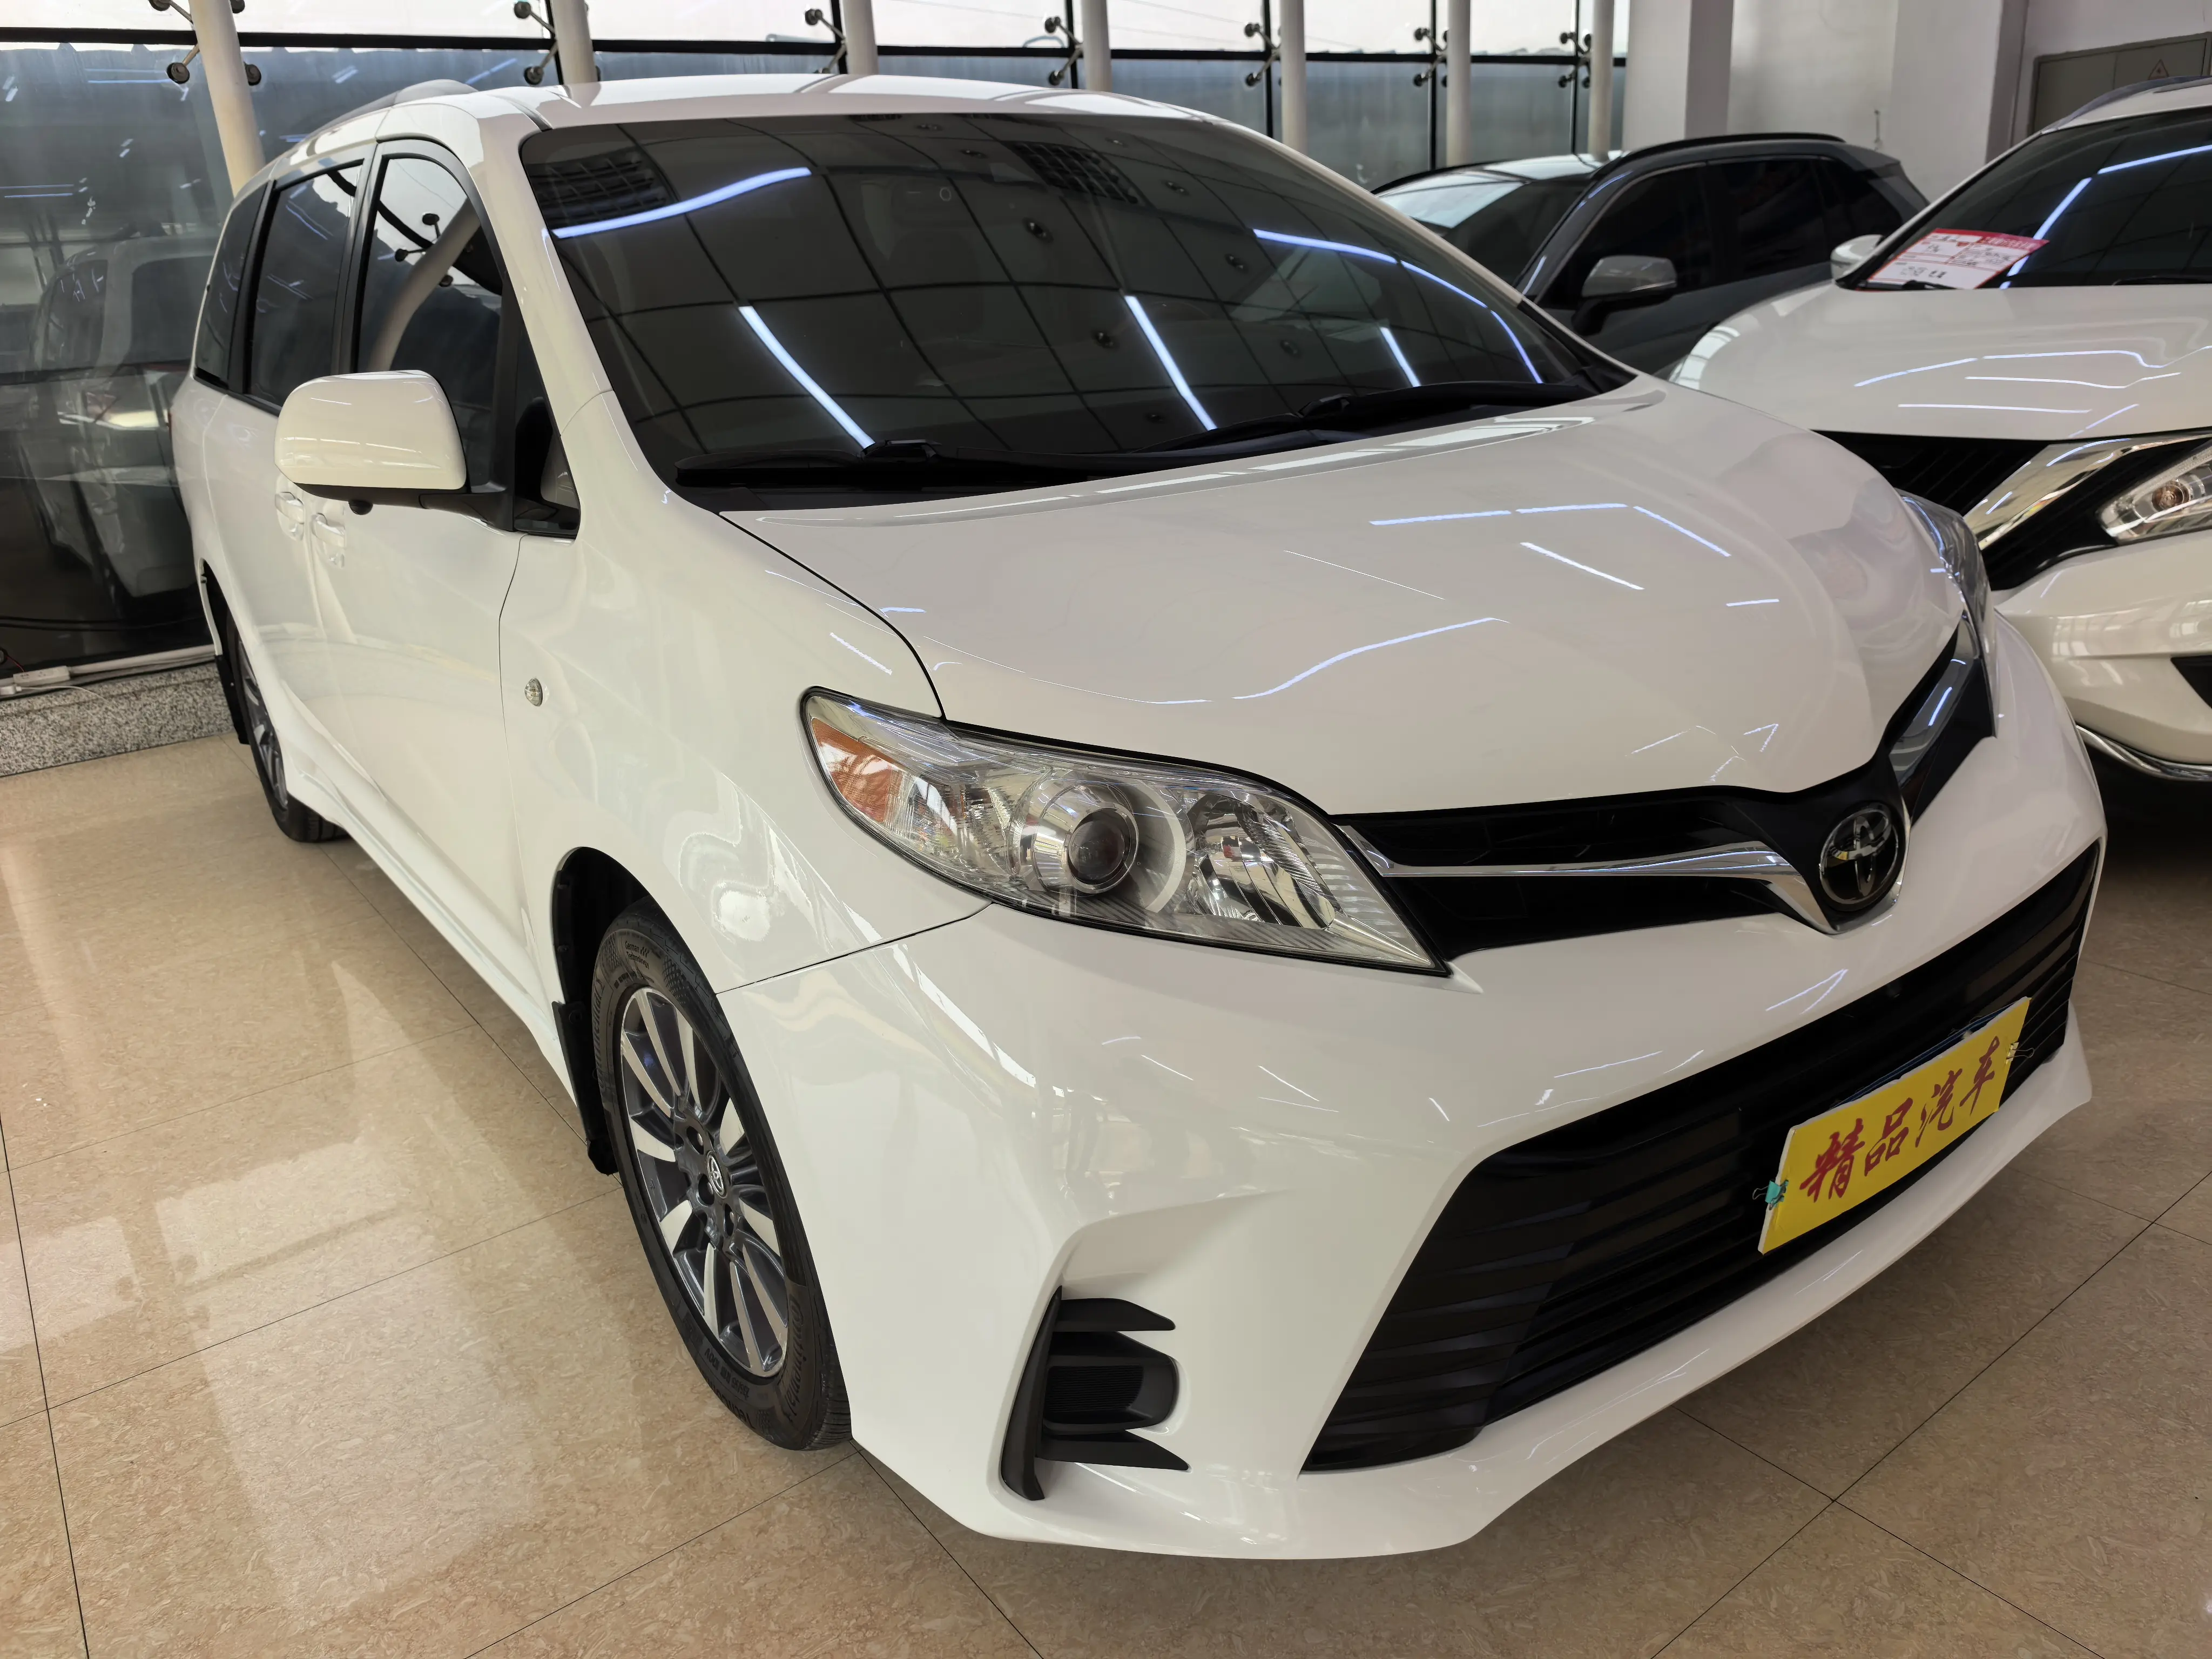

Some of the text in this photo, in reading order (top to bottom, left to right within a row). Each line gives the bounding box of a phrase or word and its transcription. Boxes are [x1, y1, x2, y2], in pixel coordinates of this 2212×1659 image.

[625, 941, 639, 952] German
[1800, 1036, 2000, 1202] 精品汽车
[786, 1294, 807, 1415] Continental
